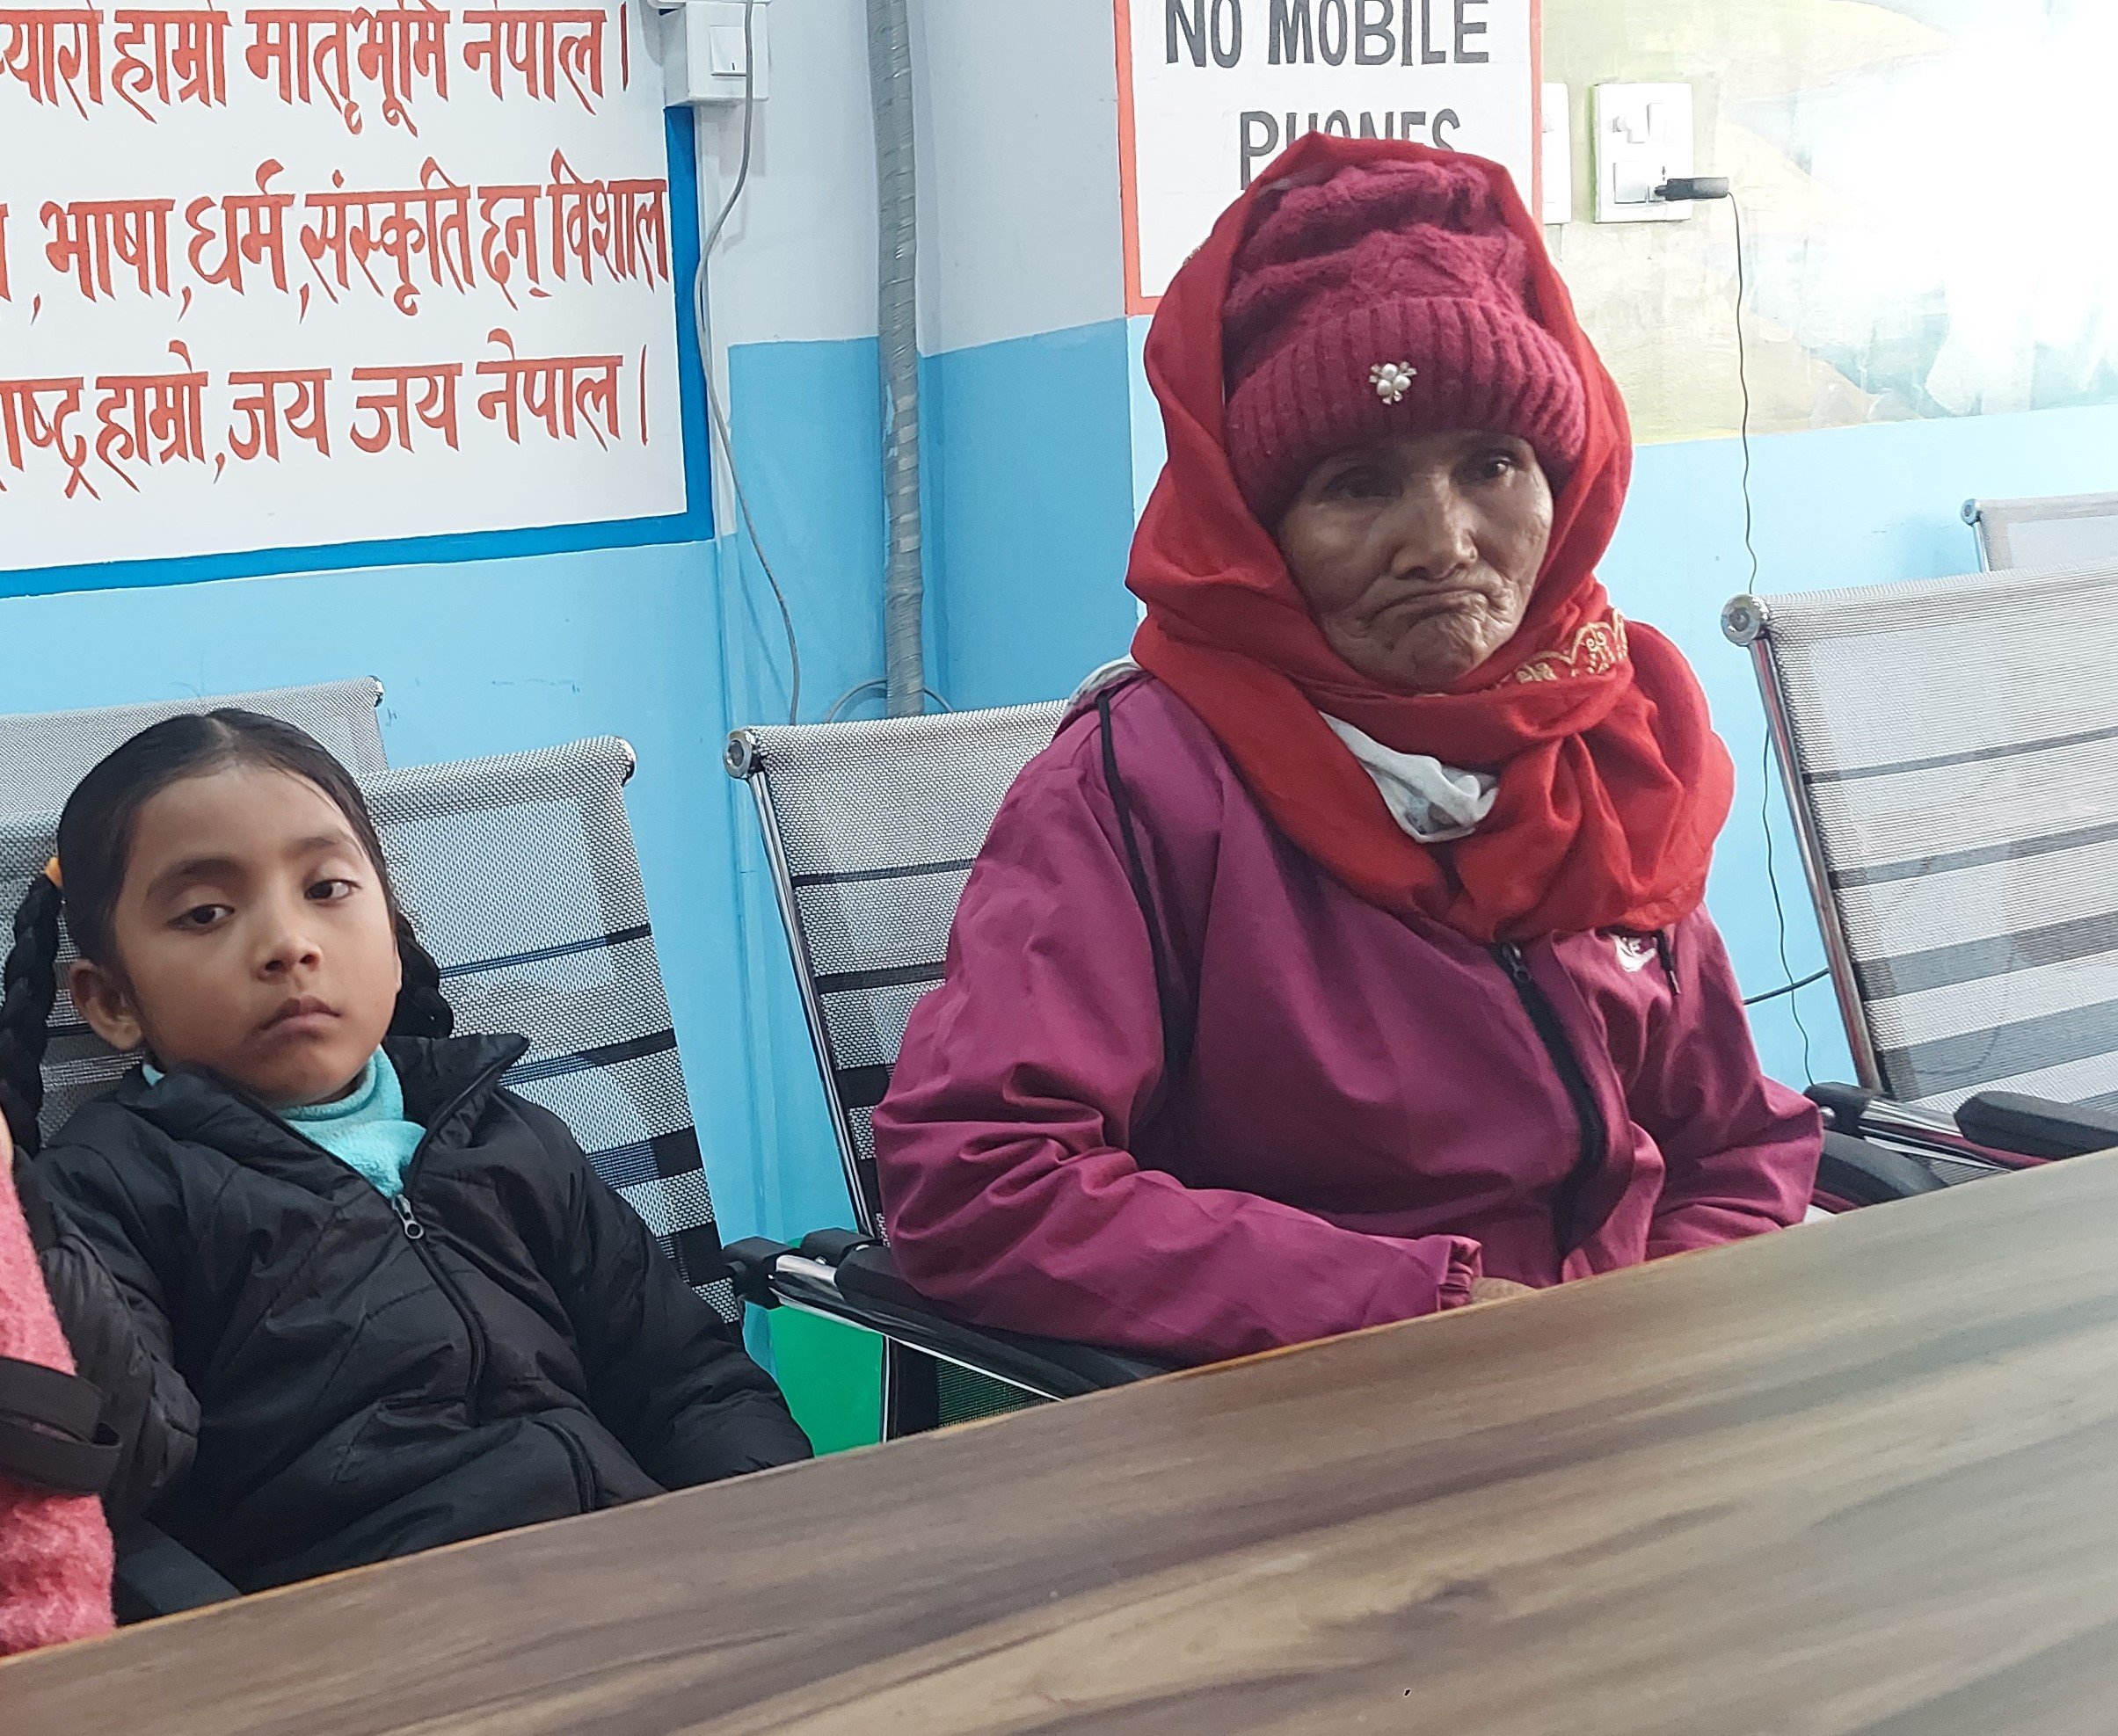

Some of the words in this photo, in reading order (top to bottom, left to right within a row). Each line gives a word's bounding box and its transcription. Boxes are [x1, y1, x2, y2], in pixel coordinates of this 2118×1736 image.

[1166, 0, 1242, 68] NO
[1268, 0, 1489, 67] MOBILE
[300, 156, 477, 316] संस्कृति
[545, 148, 669, 293] विशाल
[228, 368, 332, 463] जय
[350, 362, 463, 454] जय
